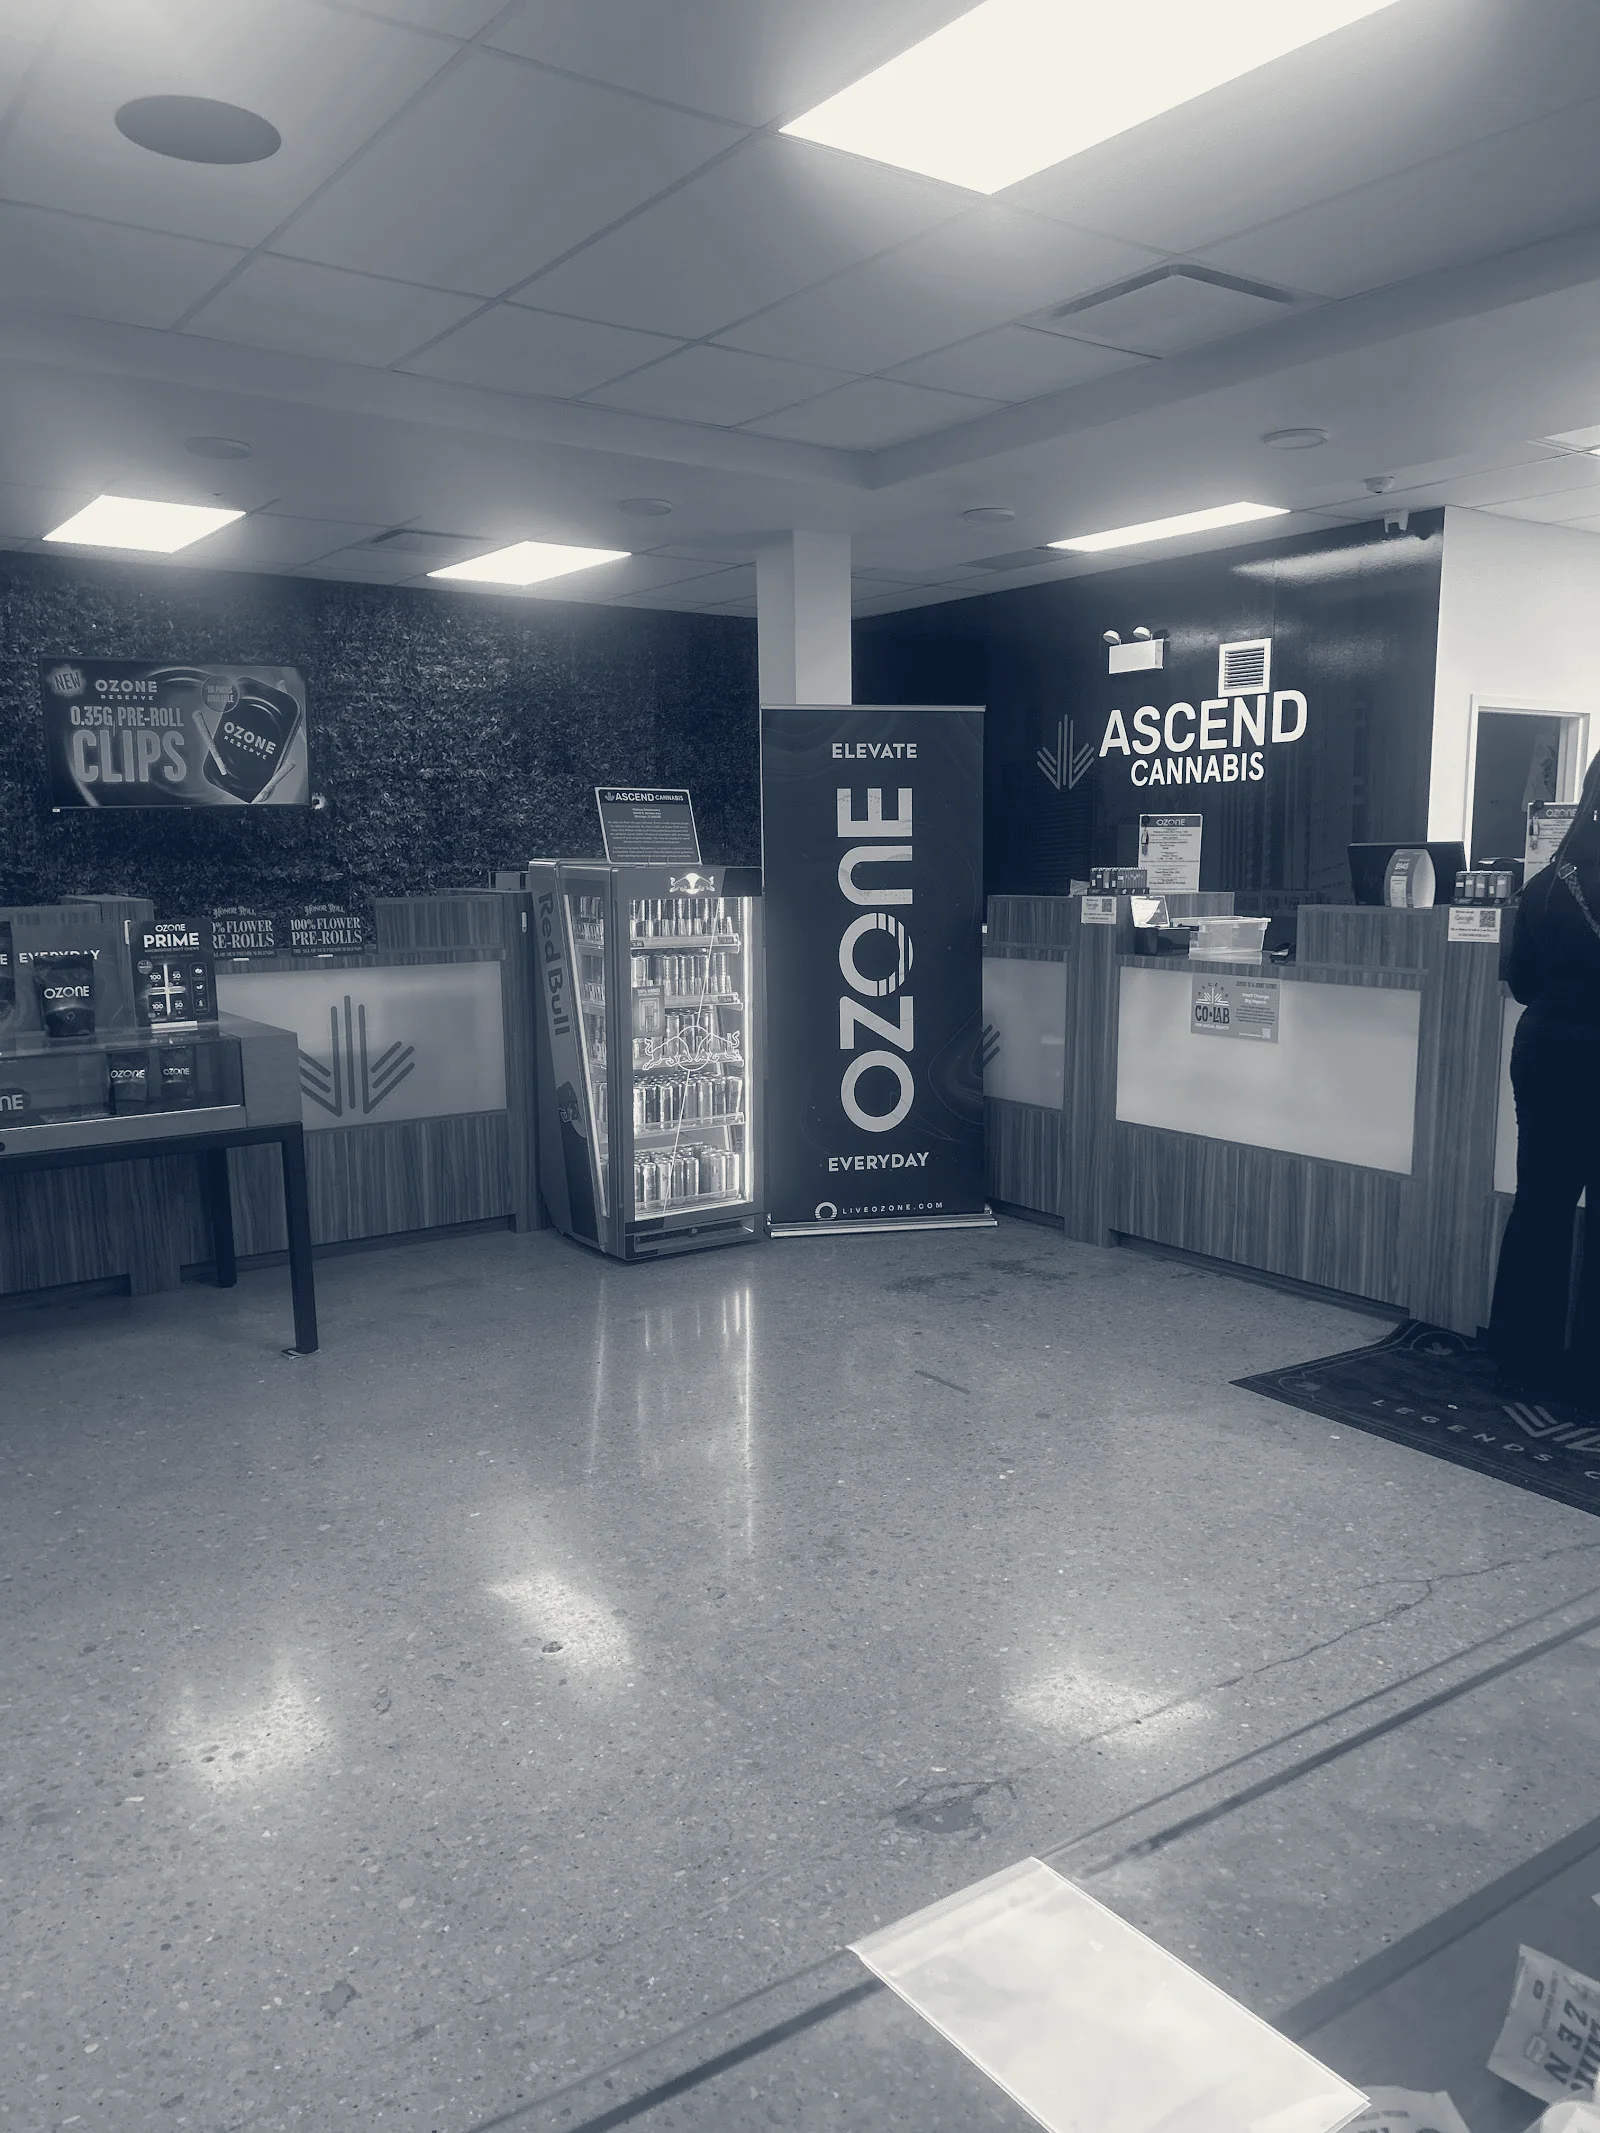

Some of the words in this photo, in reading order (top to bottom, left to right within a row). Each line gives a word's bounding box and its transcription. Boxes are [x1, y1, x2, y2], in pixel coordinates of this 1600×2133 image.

[54, 671, 82, 691] NEW
[95, 679, 158, 693] OZONE
[70, 705, 113, 726] 0.35G
[117, 706, 185, 727] PRE-ROLL
[1099, 690, 1308, 758] ASCEND
[223, 721, 277, 755] OZONE
[72, 729, 188, 783] CLIPS
[832, 742, 918, 759] ELEVATE
[1130, 752, 1265, 787] CANNABIS
[615, 791, 655, 802] ASCEND
[654, 793, 684, 802] CANNABIS
[1546, 808, 1578, 818] OZONE
[1155, 817, 1186, 827] OZONE
[226, 919, 273, 933] FLOWER
[290, 918, 316, 931] 100%
[317, 916, 361, 930] FLOWER
[1454, 914, 1475, 923] Google
[155, 923, 186, 932] OZONE
[538, 892, 562, 965] Red
[143, 933, 200, 948] PRIME
[212, 932, 275, 949] RE-ROLLS
[291, 929, 363, 946] PRE-ROLLS
[836, 787, 915, 1133] OZONE
[44, 985, 90, 999] OZONE
[547, 967, 571, 1036] Bull
[110, 1069, 146, 1079] OZONE
[163, 1067, 190, 1076] OZONE
[828, 1151, 930, 1173] EVERYDAY
[842, 1202, 943, 1215] LIVEOZONE.COM
[1371, 1399, 1553, 1463] LEGENDS
